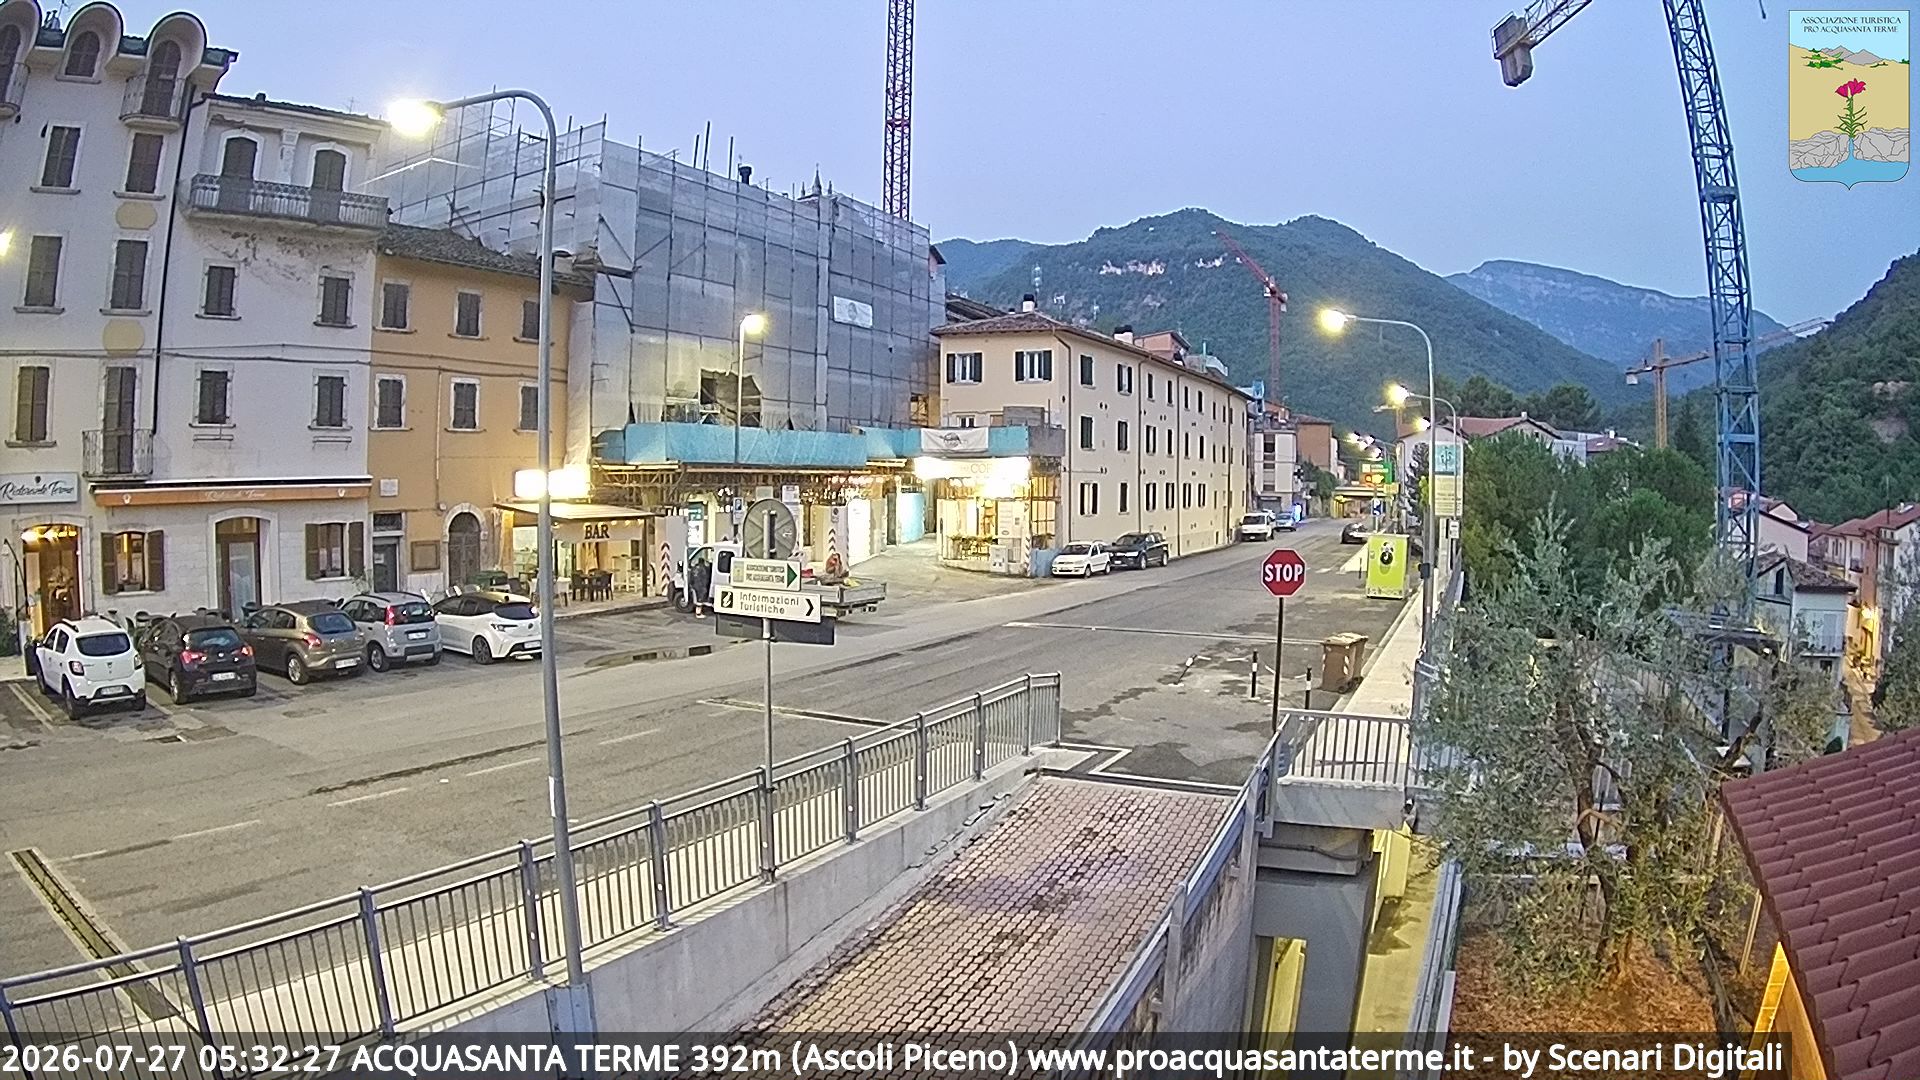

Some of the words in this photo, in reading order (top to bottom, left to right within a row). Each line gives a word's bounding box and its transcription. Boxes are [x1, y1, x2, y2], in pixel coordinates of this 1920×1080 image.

[584, 524, 610, 539] BAR
[1264, 563, 1304, 582] STOP
[740, 591, 799, 606] Informazioni
[740, 602, 785, 615] Turistiche
